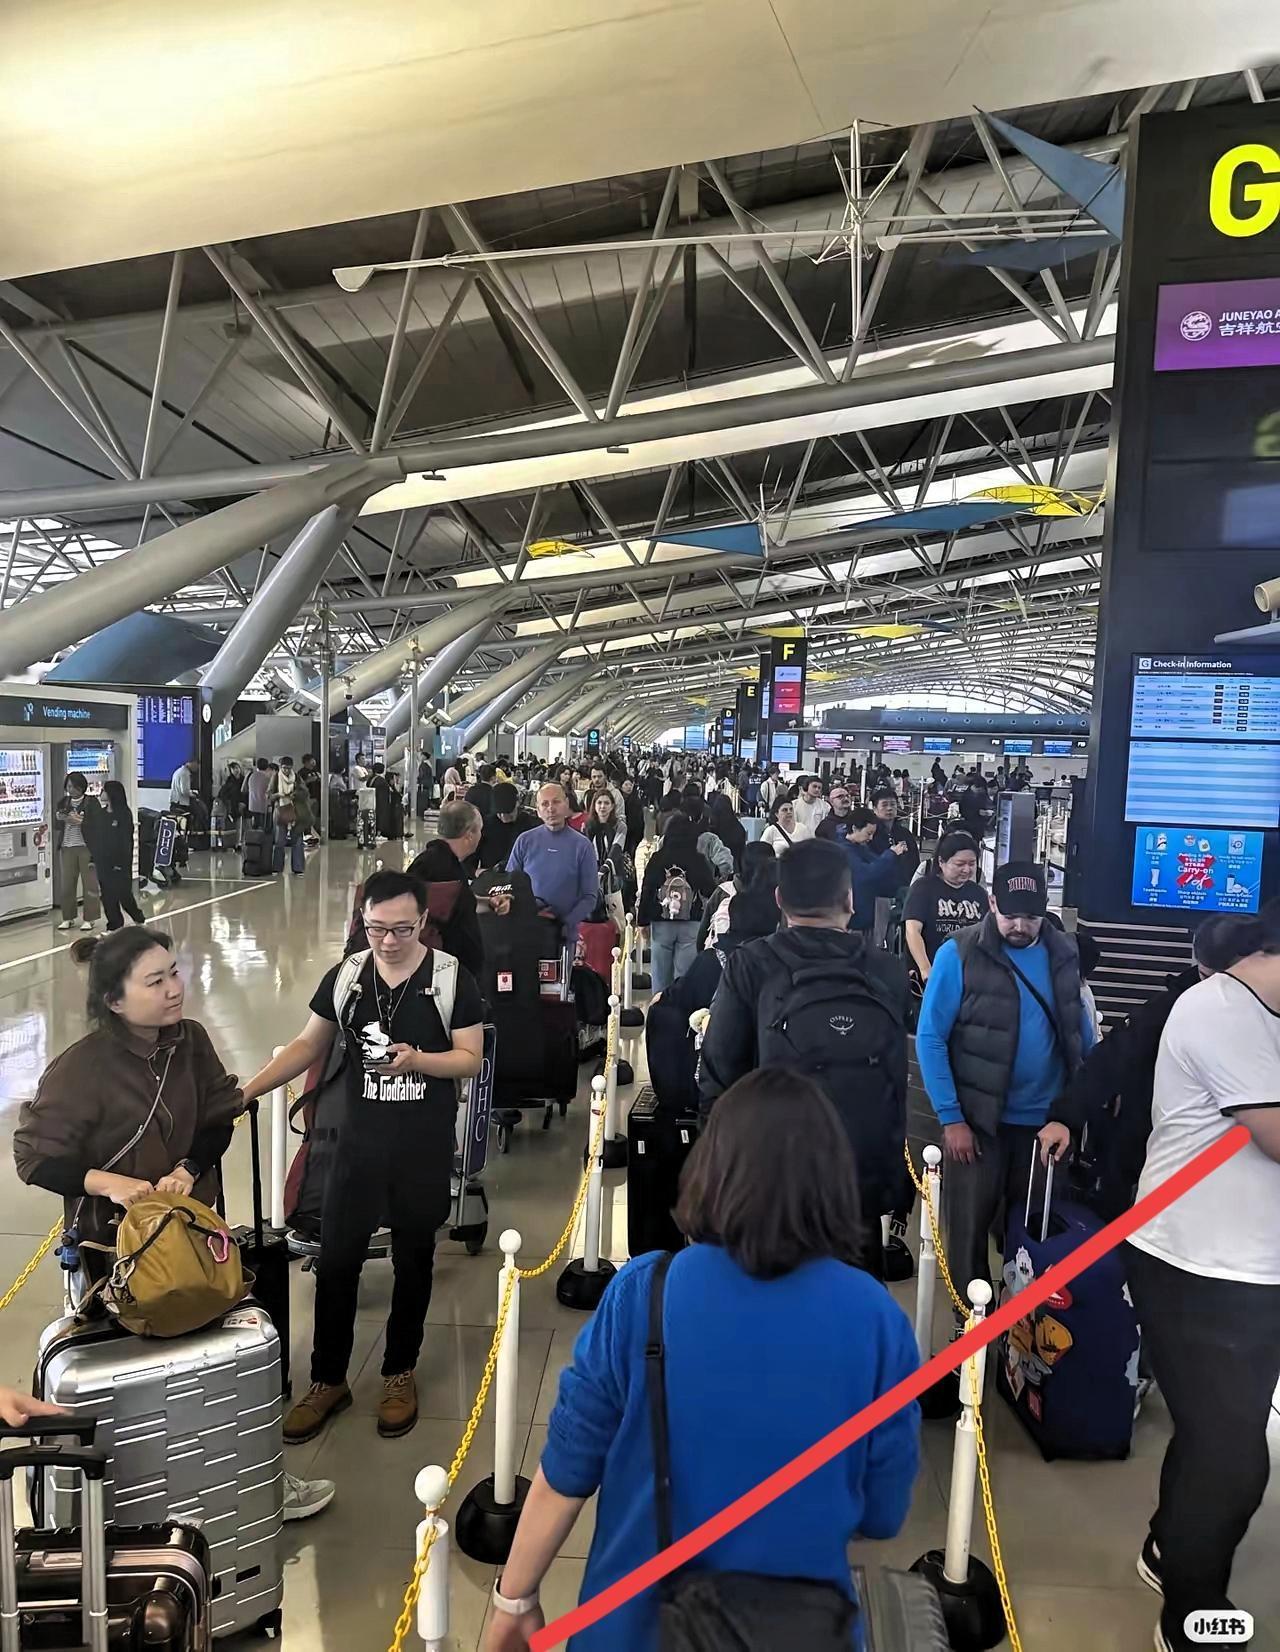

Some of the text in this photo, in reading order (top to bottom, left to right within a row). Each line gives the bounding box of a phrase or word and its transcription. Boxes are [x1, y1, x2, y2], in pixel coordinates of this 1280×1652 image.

[1209, 144, 1280, 238] G
[1219, 309, 1273, 322] JUNEYAO
[783, 643, 795, 661] F
[1153, 660, 1185, 669] Check-in
[1186, 660, 1232, 669] Information
[747, 686, 756, 697] E
[43, 705, 91, 720] Vending machine
[726, 709, 732, 717] D
[160, 829, 172, 856] DHC
[1177, 865, 1214, 875] Carry-on
[362, 1072, 427, 1102] The Godfather
[475, 1057, 491, 1142] DHC
